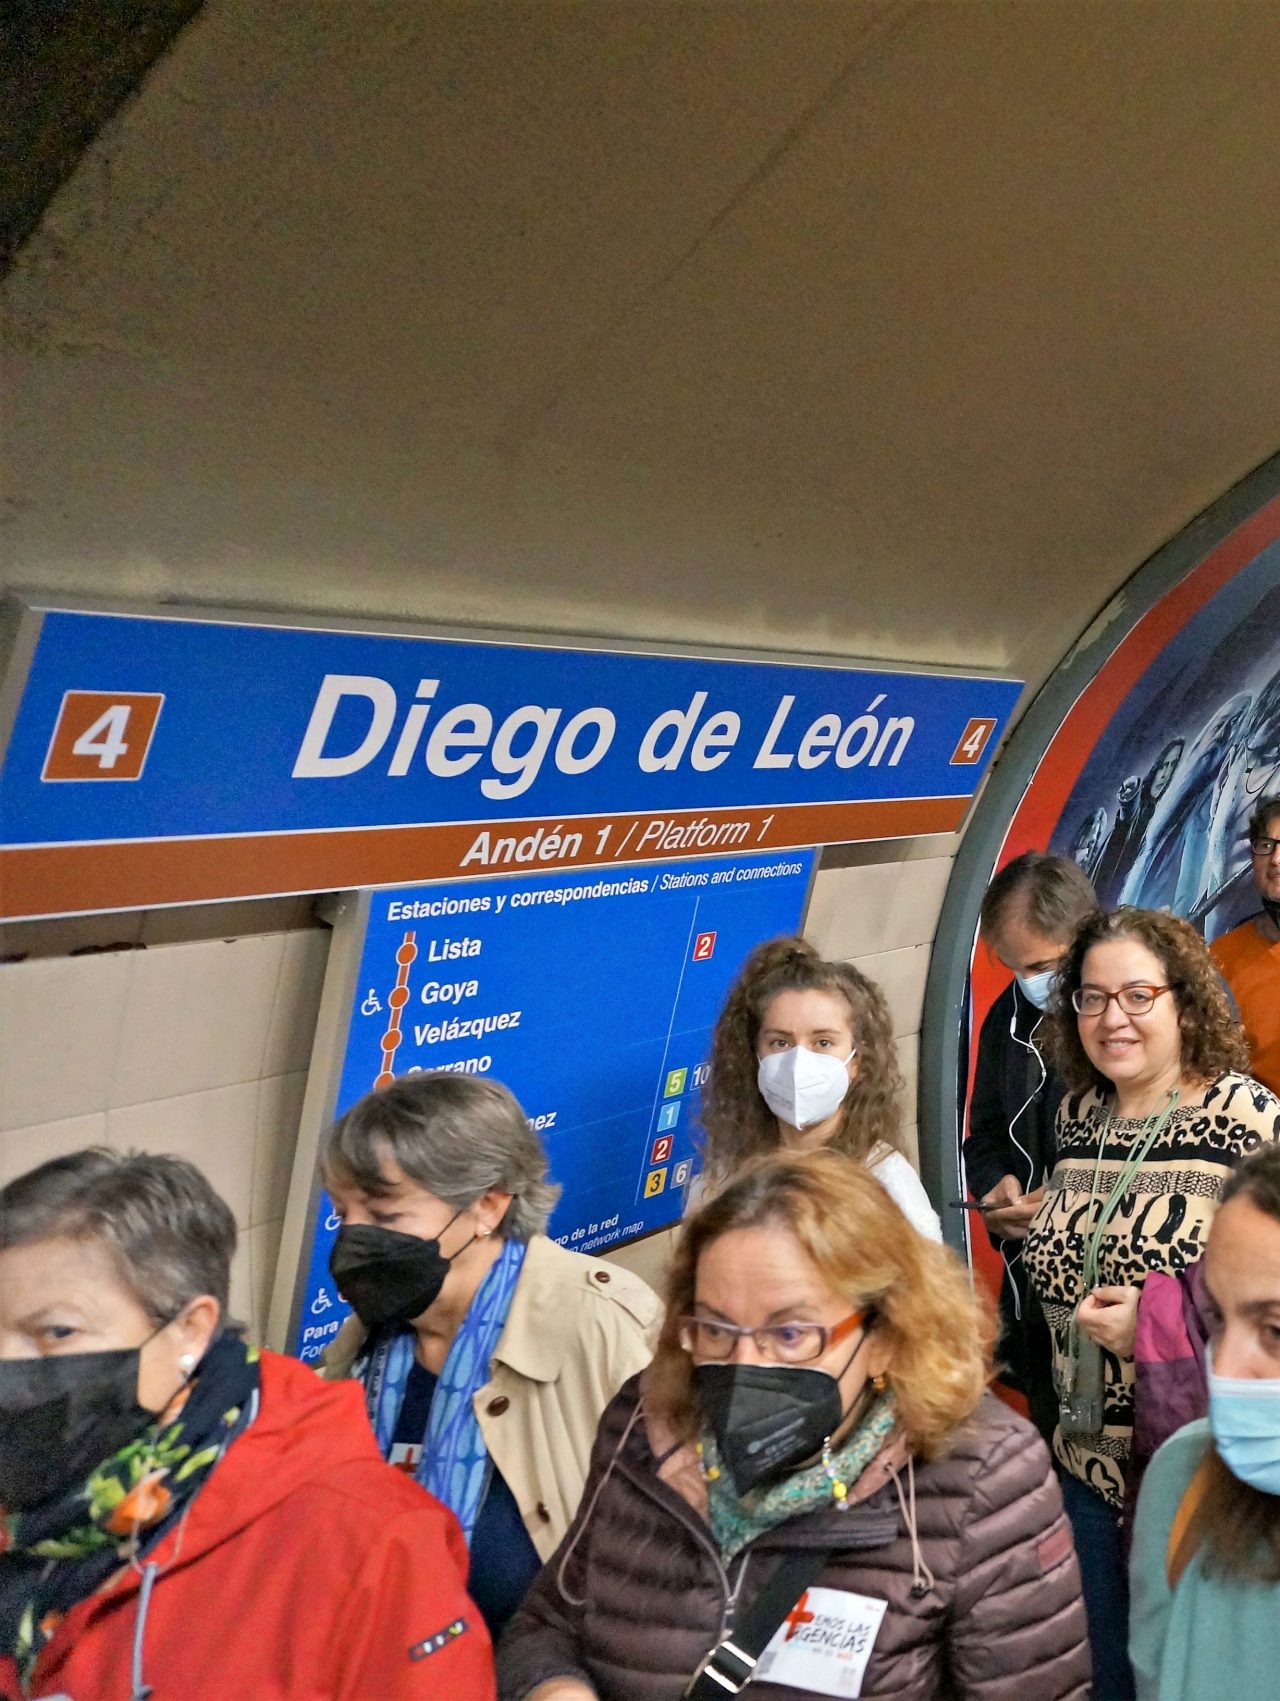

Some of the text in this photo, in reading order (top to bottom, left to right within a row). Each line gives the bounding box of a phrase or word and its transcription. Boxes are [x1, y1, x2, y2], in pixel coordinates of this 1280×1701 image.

[72, 674, 986, 801] 4 Diego de León 4
[459, 814, 775, 867] Andén 1 / Platform 1
[387, 861, 803, 922] Estaciones y correspondencias / Stations and connections
[428, 935, 711, 963] Lista 2
[420, 979, 479, 1005] Goya
[413, 1010, 522, 1047] Velázquez
[669, 1064, 711, 1092] 5 10
[666, 1106, 674, 1126] 1
[655, 1139, 669, 1160] 2
[650, 1164, 688, 1192] 3 6
[571, 1228, 586, 1242] de
[587, 1223, 598, 1234] la
[600, 1213, 620, 1231] red
[580, 1228, 621, 1252] network
[621, 1221, 644, 1237] map
[303, 1320, 339, 1343] Para
[300, 1343, 327, 1362] For
